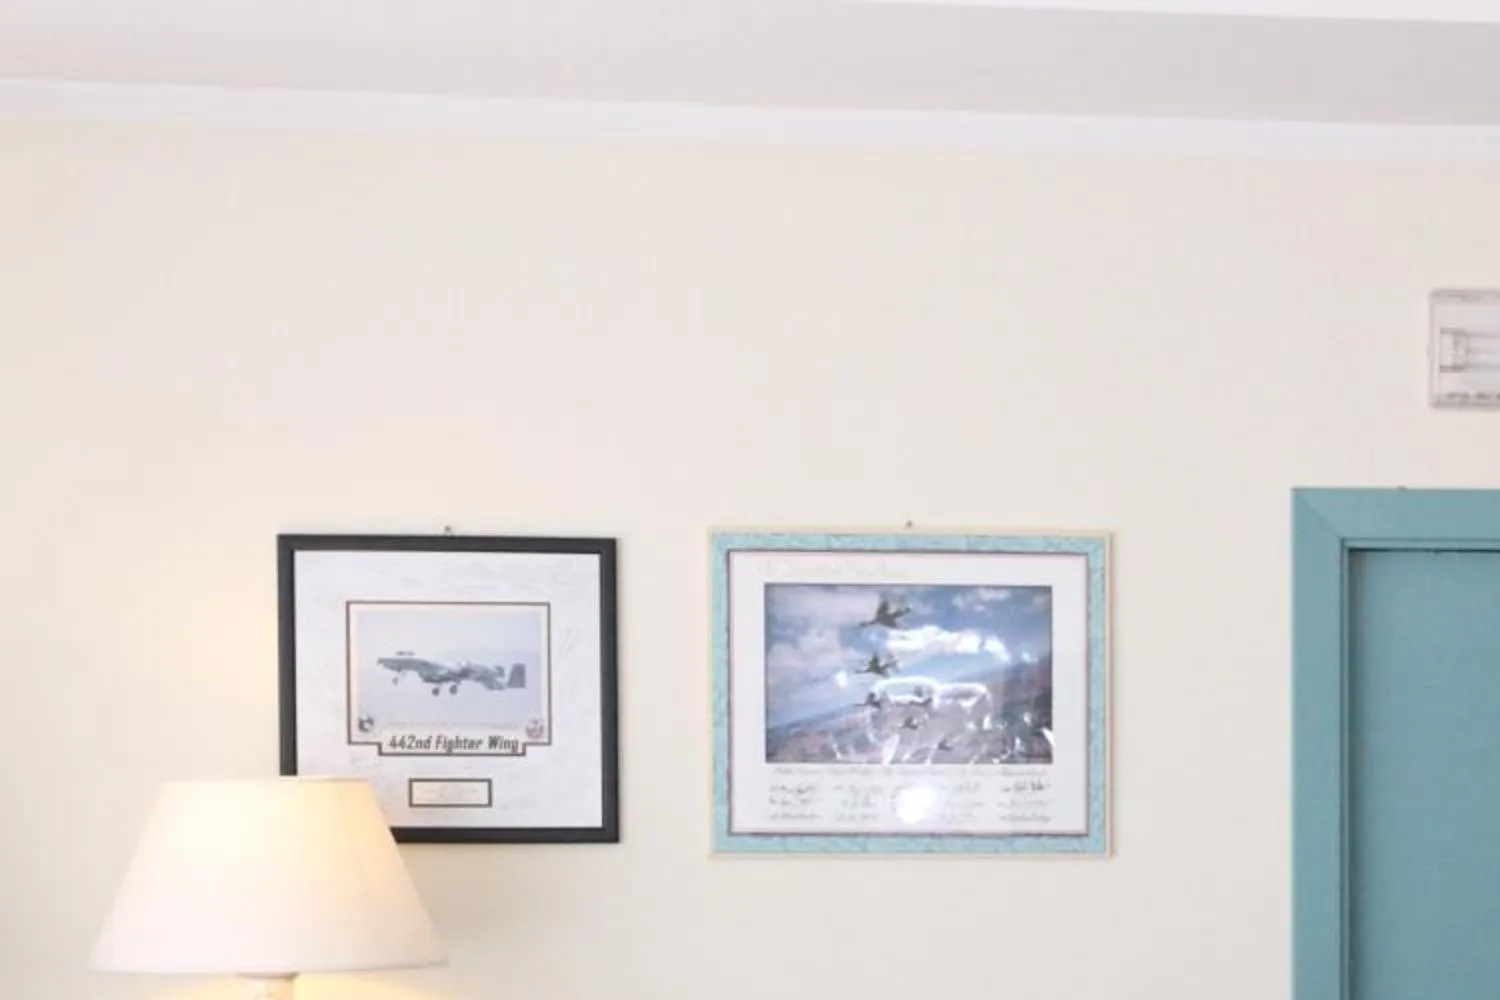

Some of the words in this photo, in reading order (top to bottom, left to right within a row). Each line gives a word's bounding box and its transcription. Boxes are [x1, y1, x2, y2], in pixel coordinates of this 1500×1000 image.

[389, 735, 432, 749] 442nd
[435, 735, 483, 753] Fighter
[487, 736, 519, 753] Wing
